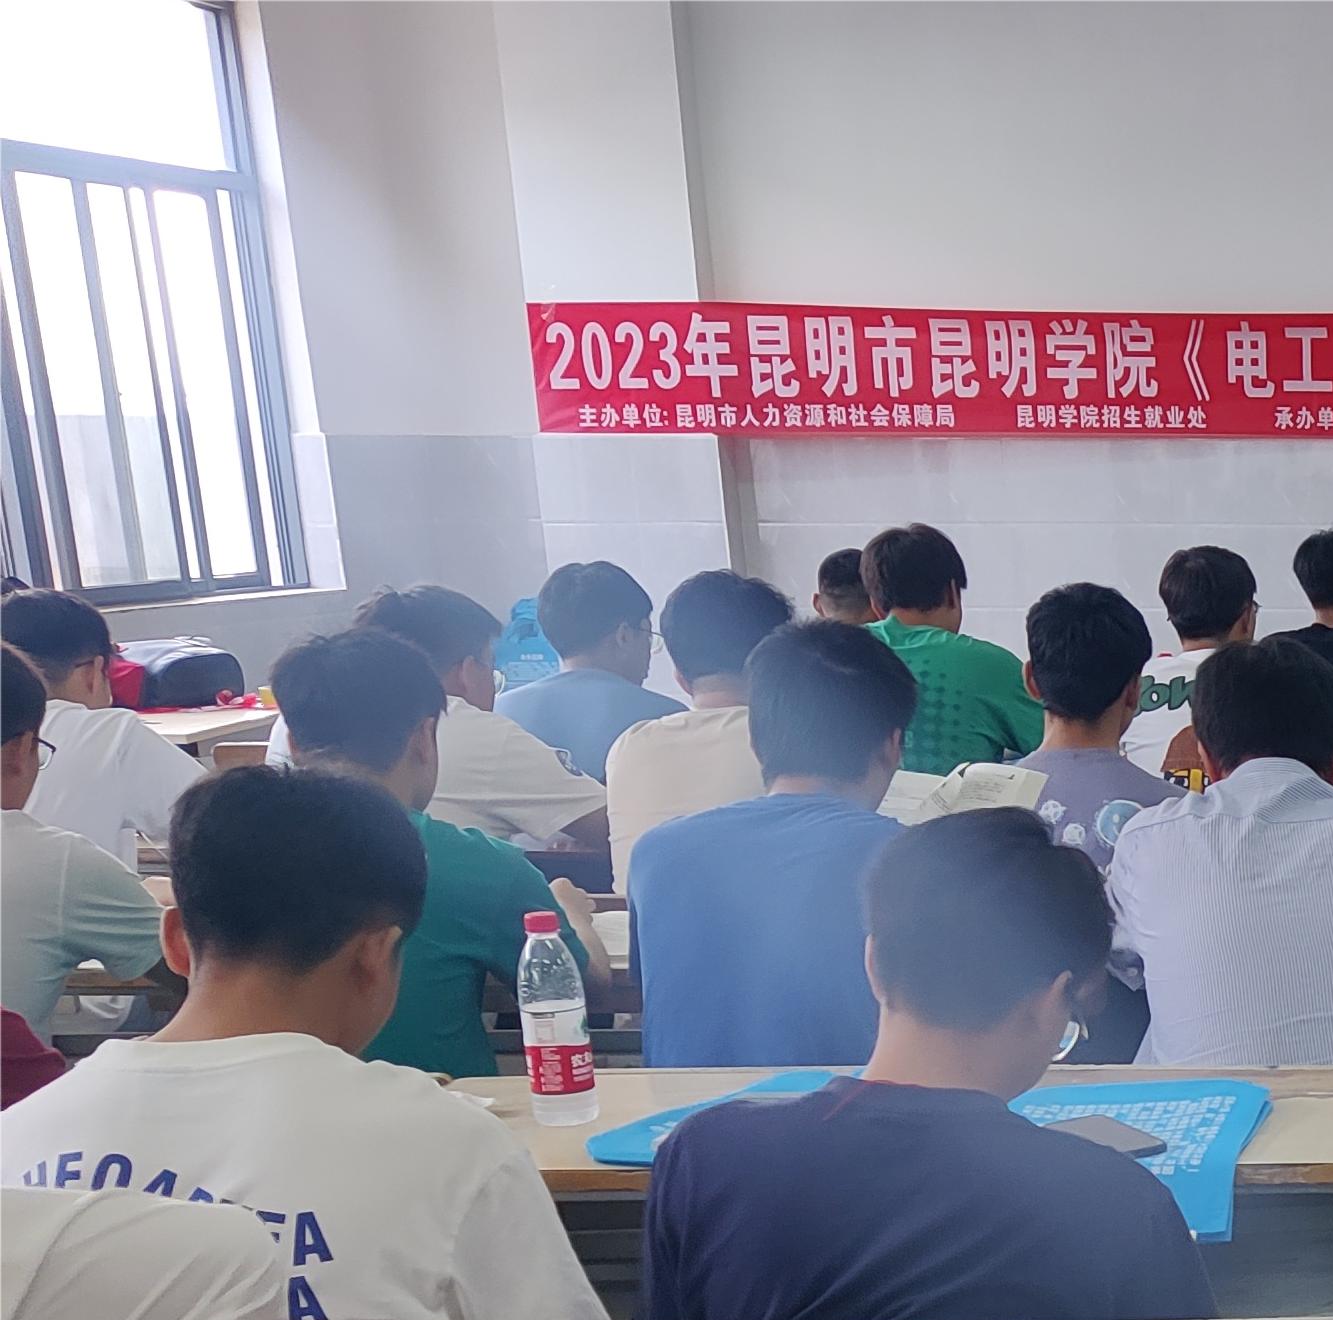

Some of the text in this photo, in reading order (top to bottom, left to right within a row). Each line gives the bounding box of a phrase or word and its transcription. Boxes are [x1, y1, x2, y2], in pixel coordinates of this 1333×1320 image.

[1016, 404, 1208, 429] 昆明学院招生就业处
